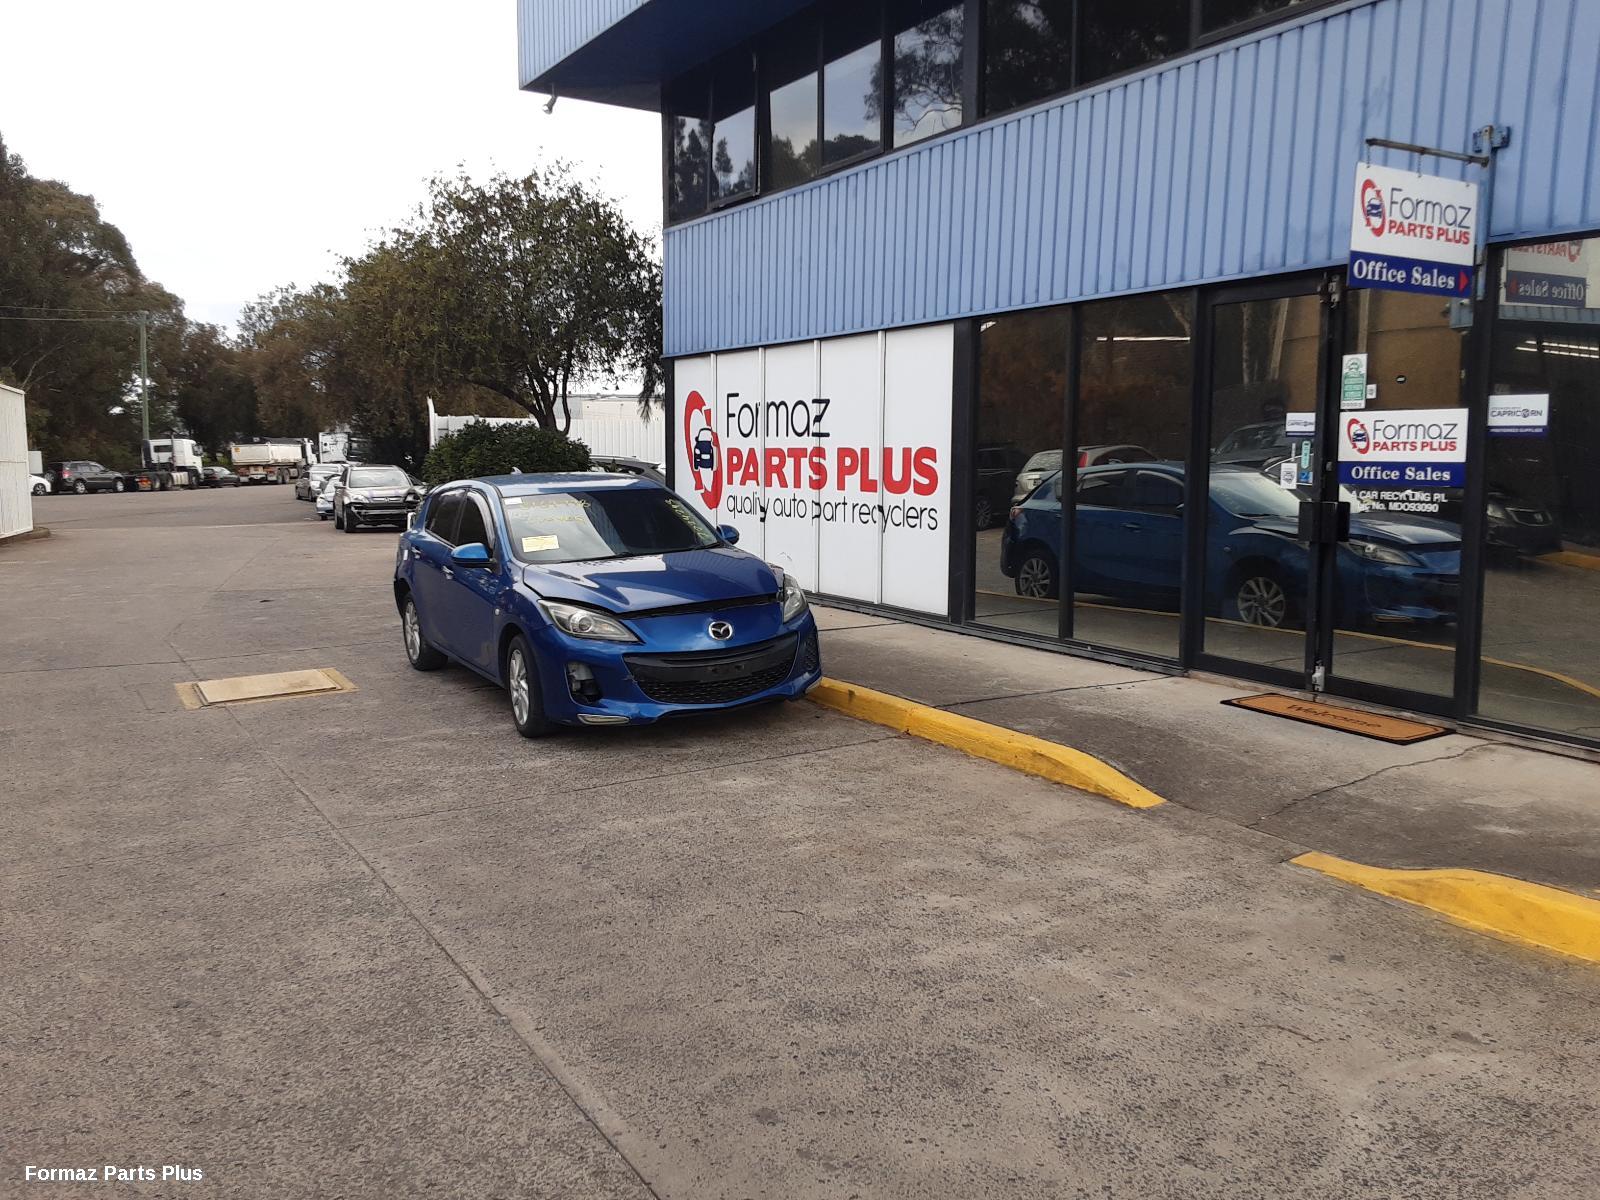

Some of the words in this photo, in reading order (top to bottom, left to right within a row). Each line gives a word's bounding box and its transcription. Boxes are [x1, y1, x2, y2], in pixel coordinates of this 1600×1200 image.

[1389, 187, 1472, 230] Formaz
[1388, 220, 1434, 240] PARTS
[1437, 227, 1470, 245] PLUS
[1353, 259, 1407, 284] Office
[1411, 266, 1455, 289] Sales
[726, 392, 831, 439] Formaz
[1373, 419, 1458, 440] Formaz
[1373, 441, 1418, 452] PARTS
[1420, 441, 1457, 452] PLUS
[726, 446, 828, 491] PARTS
[836, 446, 939, 497] PLUS
[1351, 465, 1400, 480] Office
[1404, 466, 1451, 481] Sales
[1359, 490, 1378, 500] CAR
[773, 493, 807, 519] auto
[811, 496, 848, 526] part
[852, 499, 938, 534] recyclers
